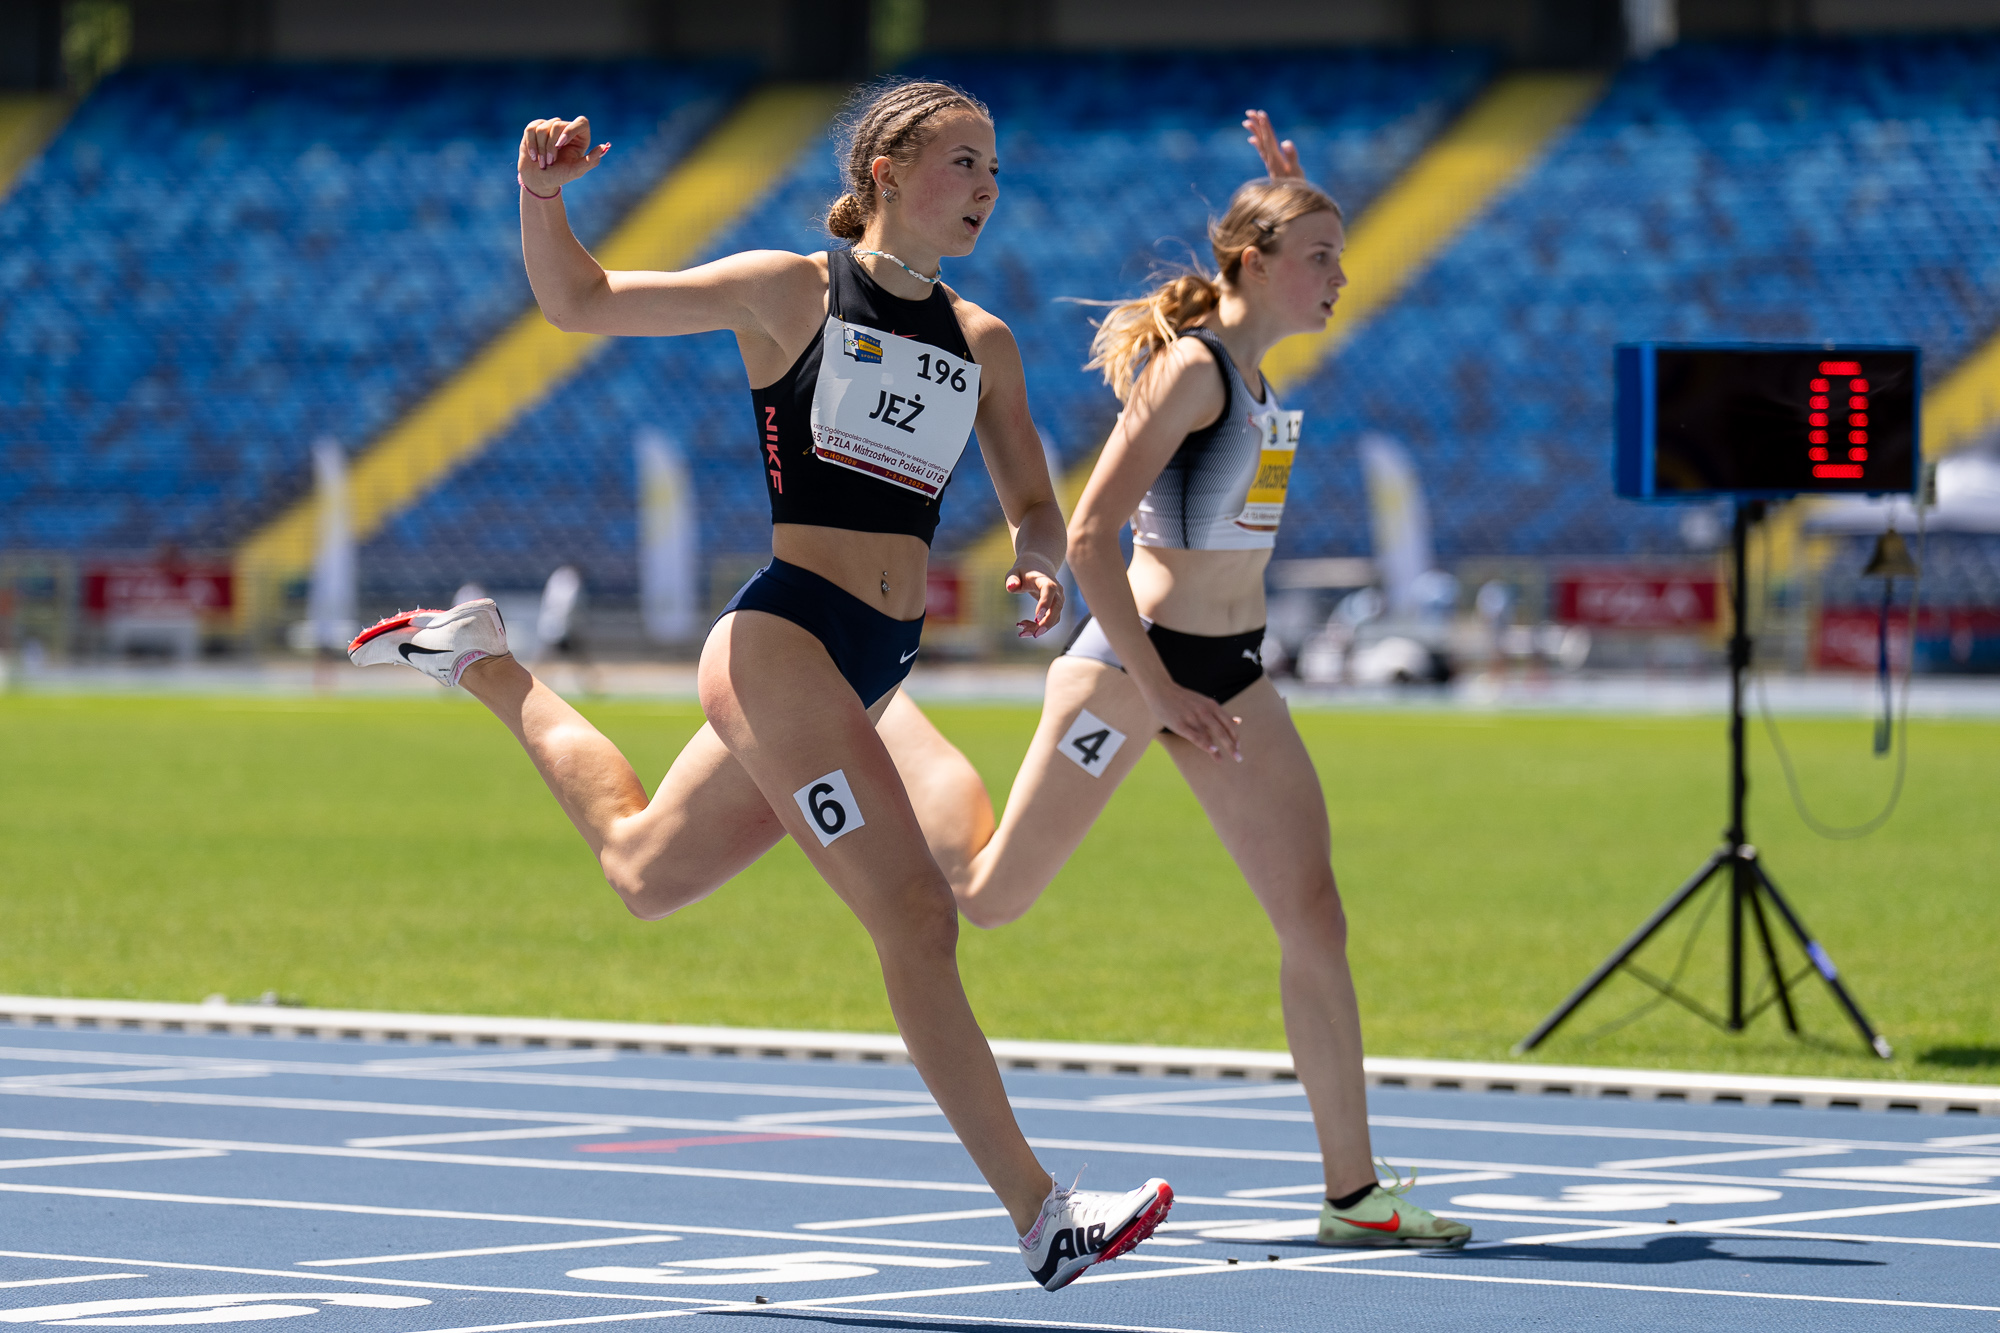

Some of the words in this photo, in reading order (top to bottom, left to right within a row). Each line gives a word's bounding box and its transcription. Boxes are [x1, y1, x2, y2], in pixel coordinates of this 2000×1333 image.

[917, 353, 966, 392] 196
[869, 390, 925, 433] JEŻ
[1808, 361, 1869, 478] 0
[823, 451, 857, 466] CHORZÓW
[827, 435, 850, 450] PZLA
[852, 443, 897, 466] Mistrzostwa
[898, 459, 926, 475] Polski
[926, 469, 945, 483] U18
[1072, 728, 1110, 767] 4
[808, 783, 846, 835] 6
[1033, 1222, 1107, 1284] AIR
